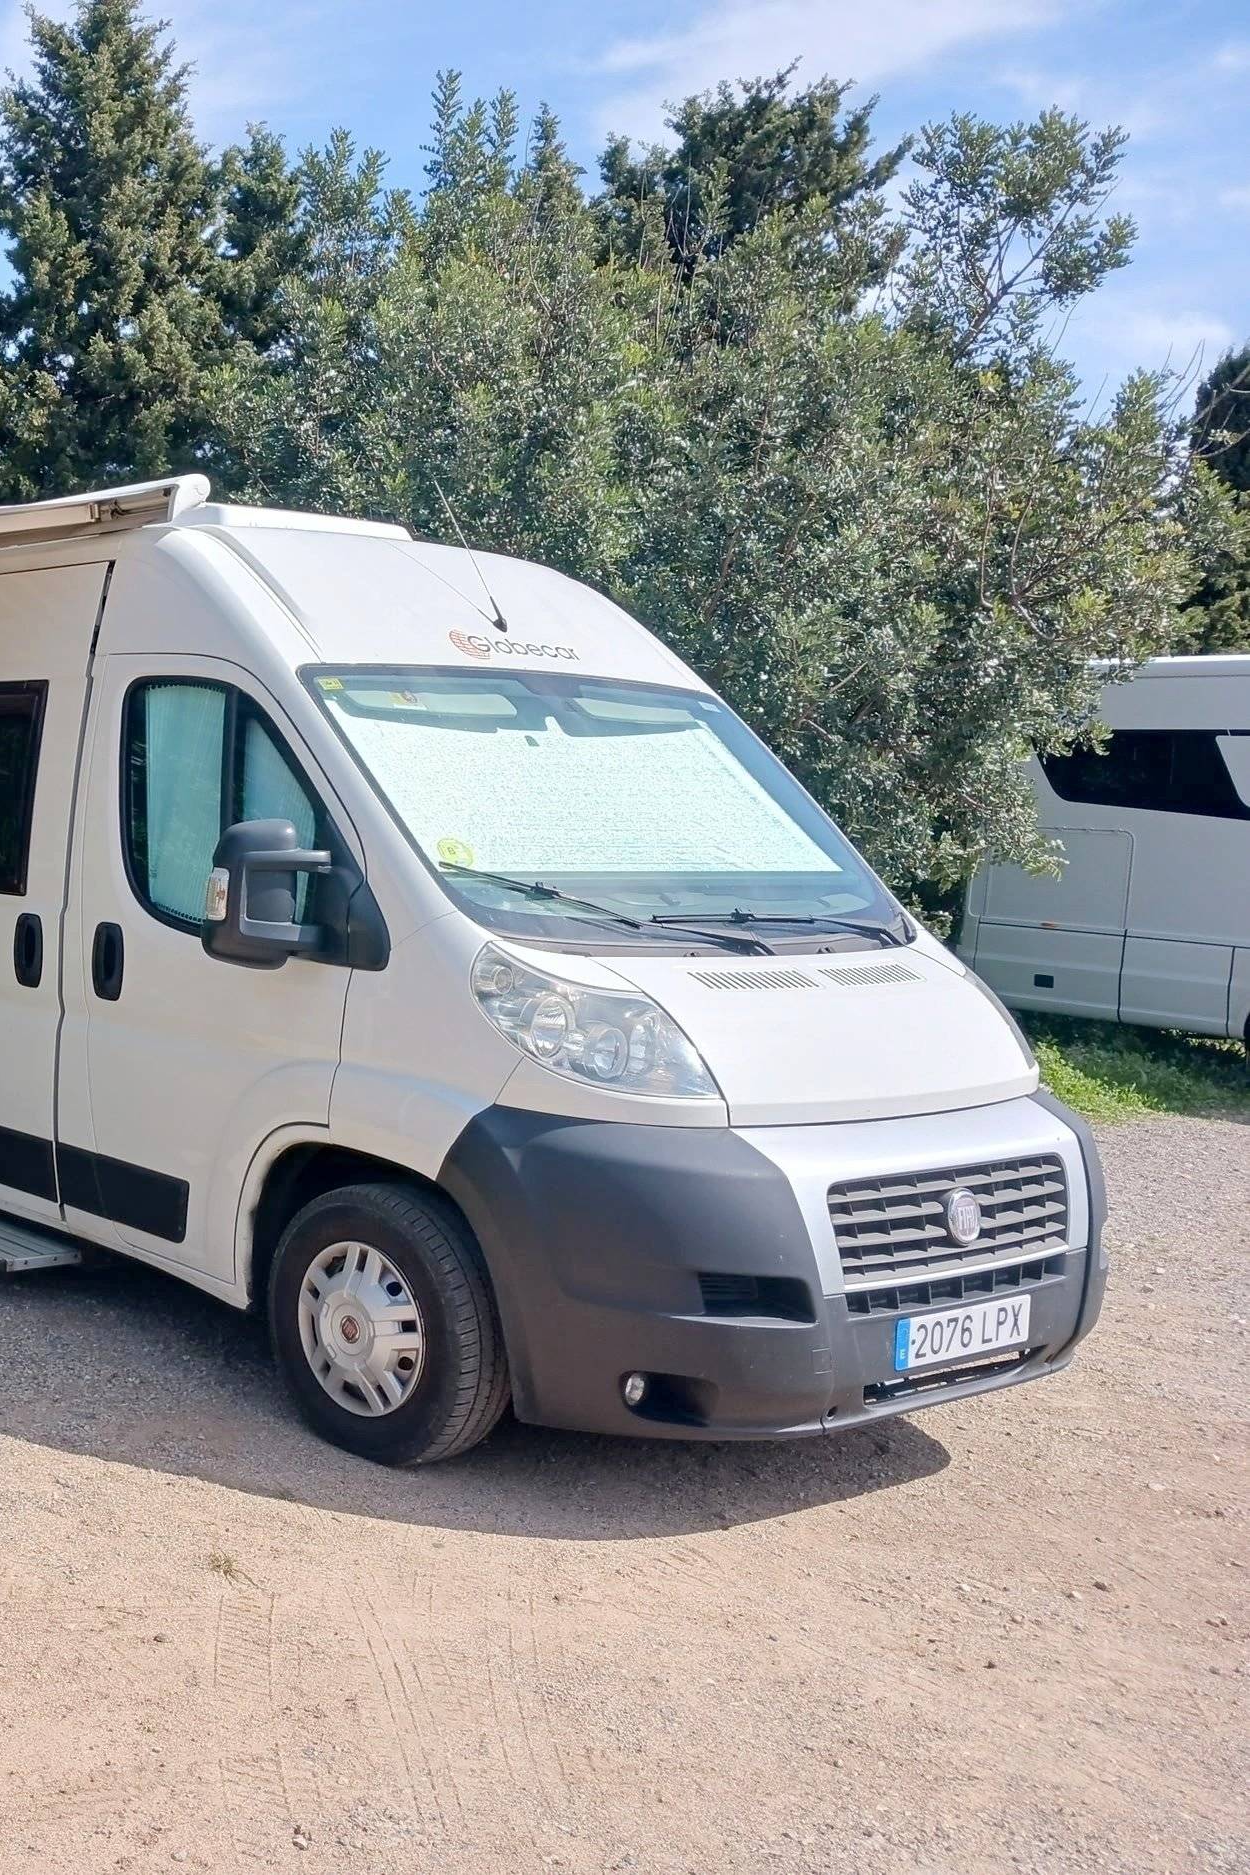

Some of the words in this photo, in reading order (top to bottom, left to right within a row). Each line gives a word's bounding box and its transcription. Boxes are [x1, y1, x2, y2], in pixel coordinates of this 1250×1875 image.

[467, 635, 581, 661] Globecar
[914, 1314, 974, 1360] 2076
[981, 1303, 1023, 1345] LPX
[899, 1349, 906, 1360] E
